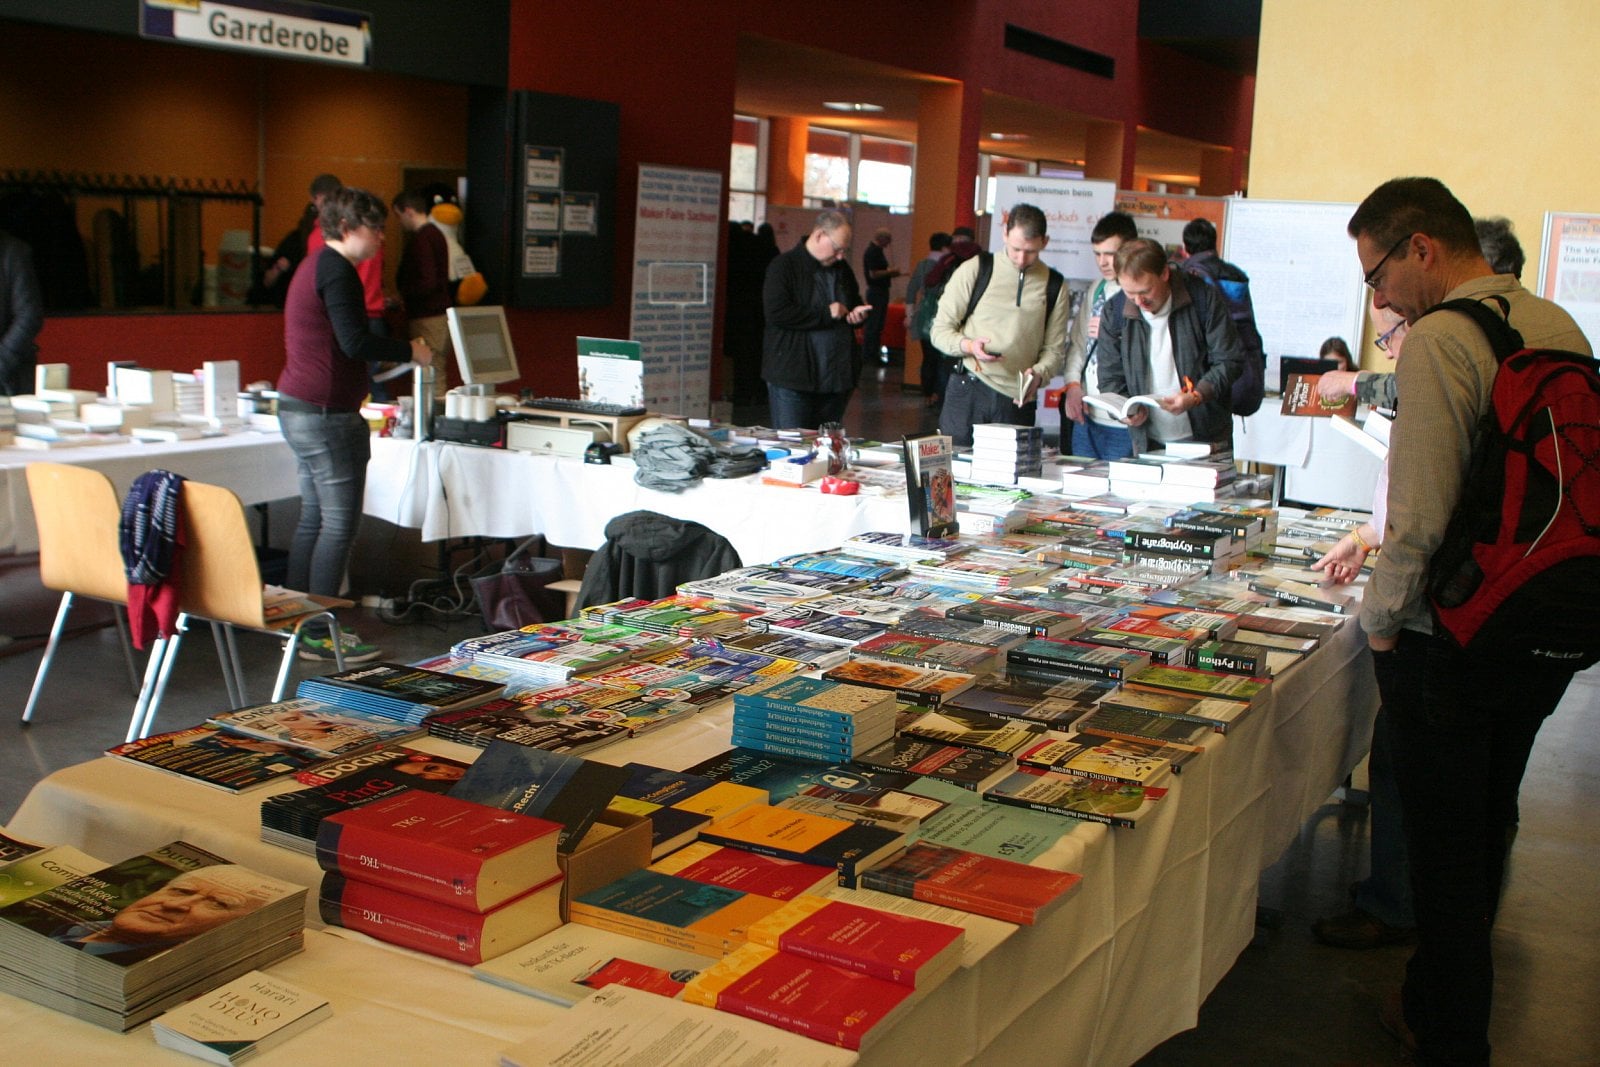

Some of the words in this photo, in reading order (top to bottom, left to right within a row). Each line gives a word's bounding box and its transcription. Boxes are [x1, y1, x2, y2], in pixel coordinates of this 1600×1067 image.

[208, 11, 350, 56] Garderobe
[1016, 185, 1071, 197] Willkommen
[1072, 187, 1094, 198] beim
[639, 206, 665, 219] Maker
[1141, 536, 1193, 553] Kryptografie
[1280, 590, 1299, 603] Icinga
[1199, 654, 1235, 669] Python
[766, 701, 796, 713] STARTHILFE
[767, 712, 798, 723] STARTHILFE
[765, 722, 796, 733] STARTHILFE
[766, 733, 796, 744] STARTHILFE
[764, 744, 795, 755] STARTHILFE
[317, 751, 406, 779] DOCMA
[735, 753, 753, 766] Ihr
[728, 759, 776, 784] schutz?
[1050, 765, 1071, 775] WRONG
[1072, 769, 1088, 778] DONE
[1089, 772, 1118, 783] STATISTICS
[326, 778, 395, 803] PinG
[514, 783, 541, 813] -Recht
[1030, 803, 1047, 814] bauen
[1048, 803, 1077, 818] Multicopter
[1088, 811, 1112, 824] Drohnen
[359, 854, 380, 869] TKG
[41, 860, 81, 880] Comp
[363, 909, 383, 924] TKG
[250, 982, 298, 1006] Harari
[219, 991, 281, 1020] HOMO
[209, 1000, 260, 1026] DEUS
